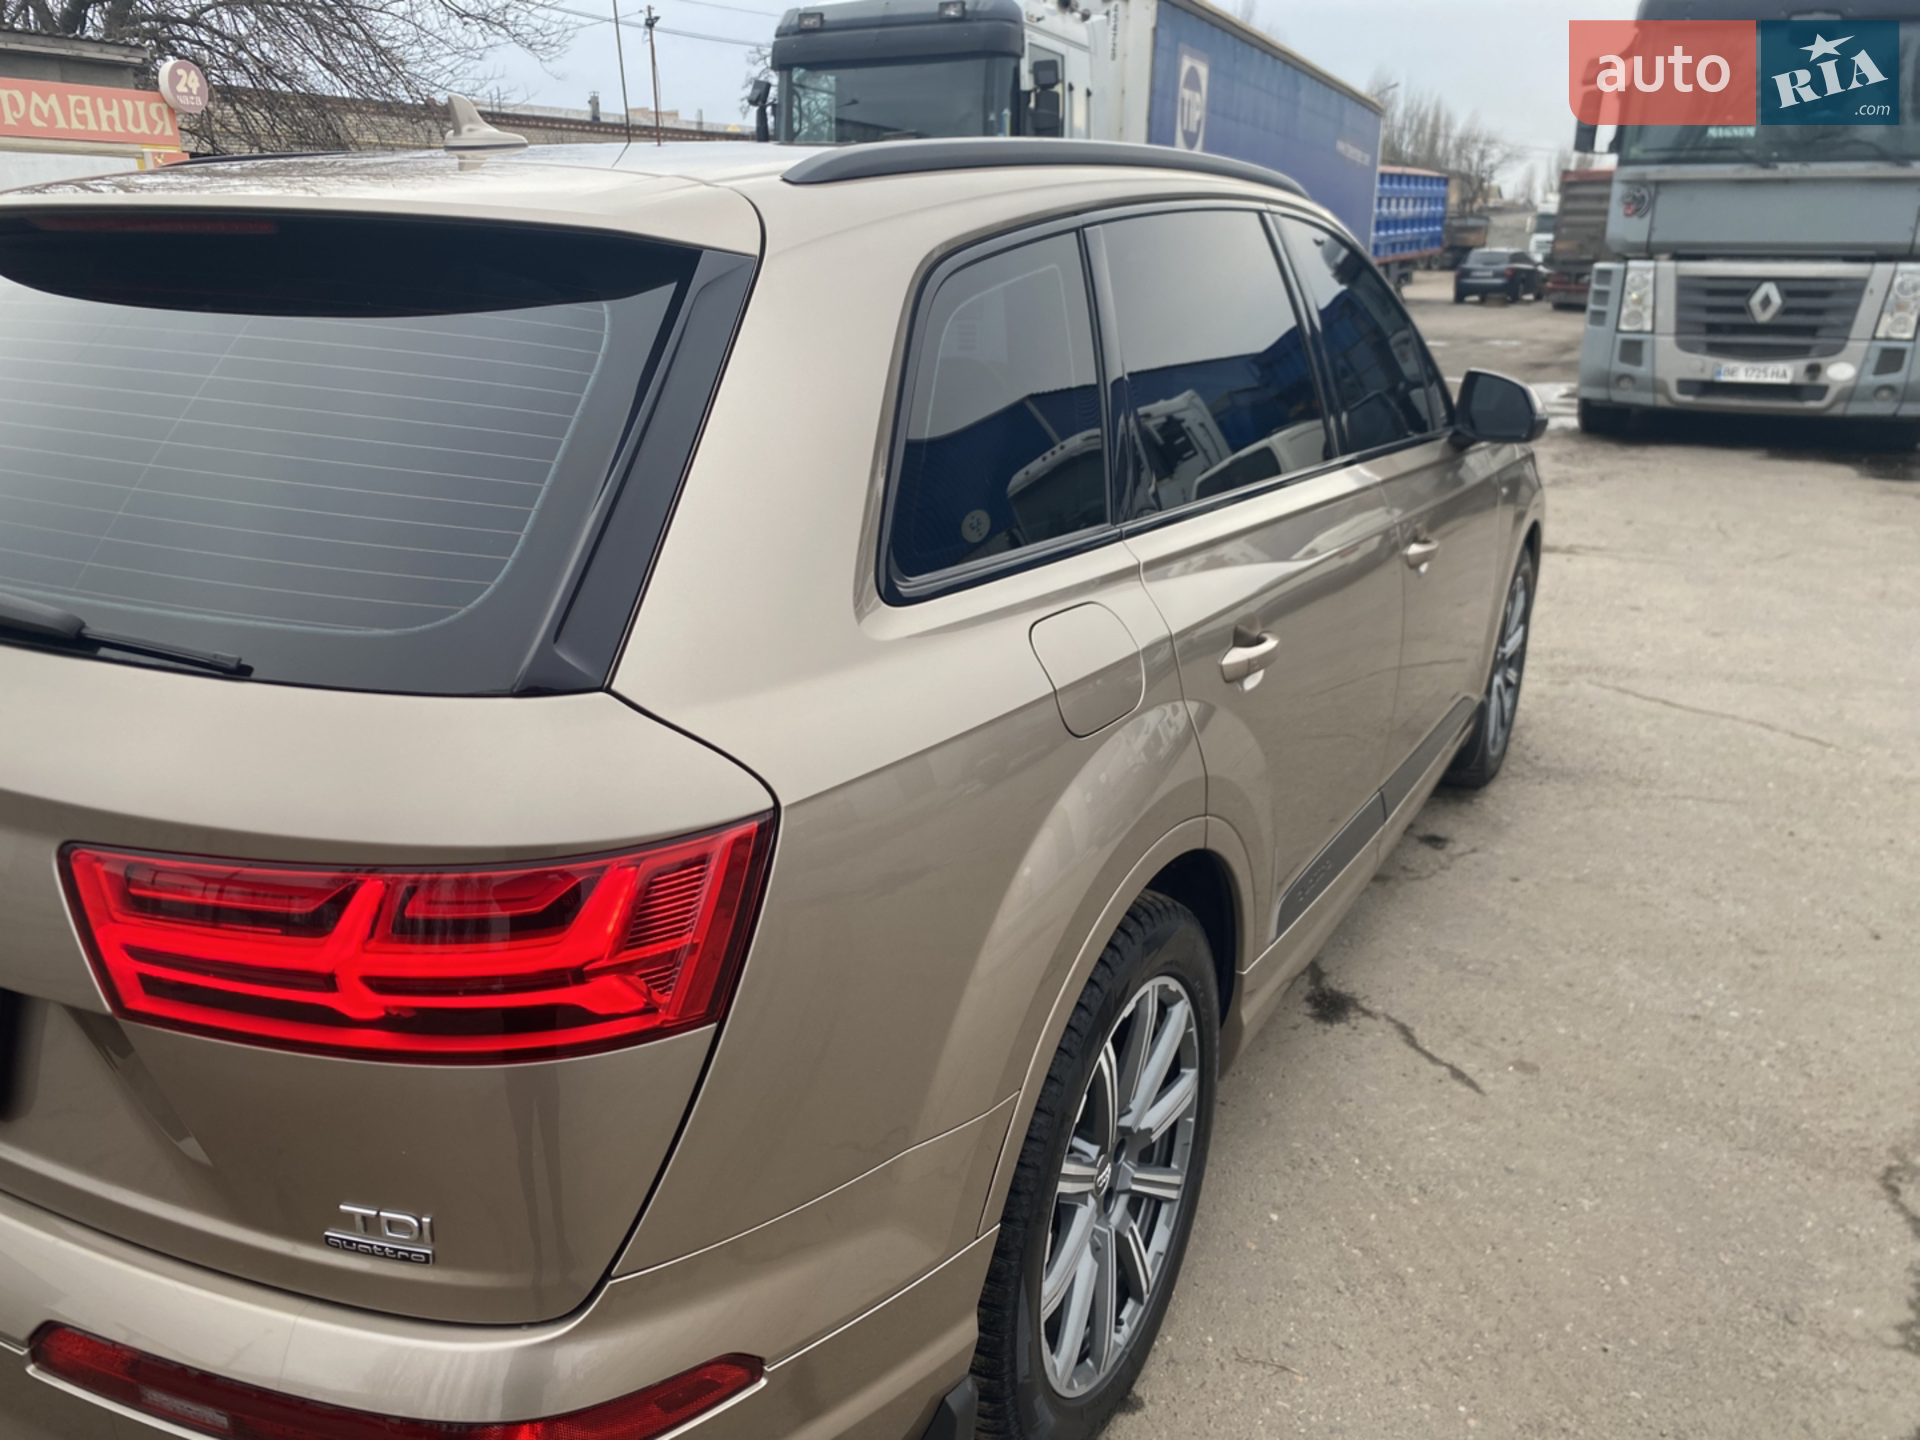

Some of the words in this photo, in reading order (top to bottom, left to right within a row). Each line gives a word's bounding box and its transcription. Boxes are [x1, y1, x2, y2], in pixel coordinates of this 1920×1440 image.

[176, 69, 200, 95] 24
[1181, 87, 1203, 133] TIP
[339, 1204, 433, 1243] TDI
[327, 1237, 426, 1262] quattro
